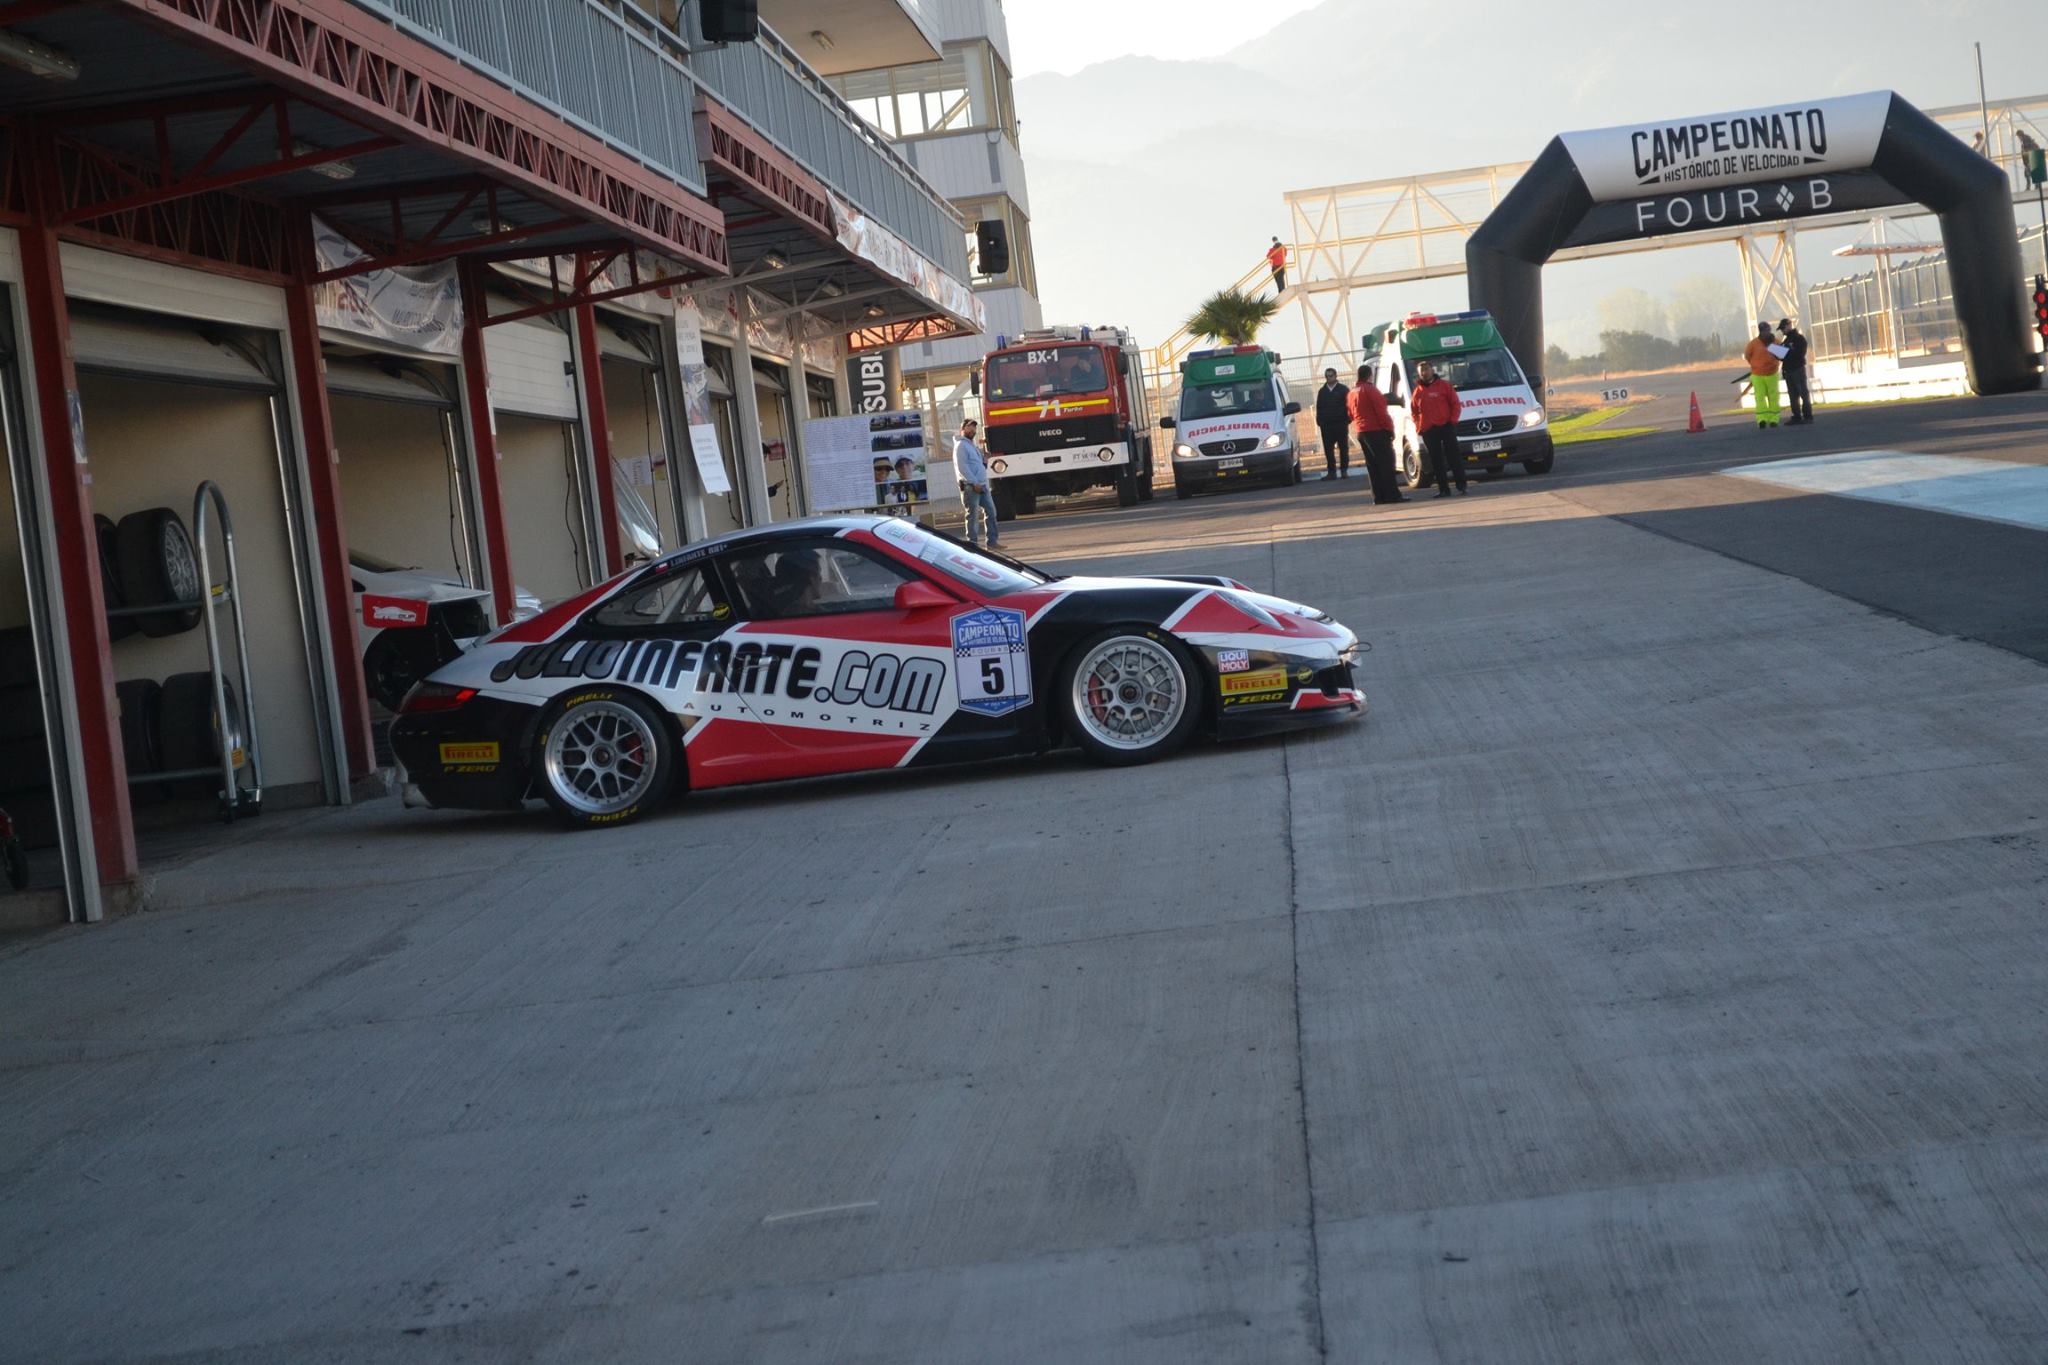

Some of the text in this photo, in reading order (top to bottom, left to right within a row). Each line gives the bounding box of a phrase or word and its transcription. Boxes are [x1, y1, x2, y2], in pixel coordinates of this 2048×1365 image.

[1631, 108, 1828, 179] CAMPEONATO
[1664, 154, 1800, 183] HISTÓRICO DE VELOCIDAD
[1636, 179, 1833, 232] FOUR B
[1027, 349, 1059, 364] BX-1
[1603, 388, 1628, 401] 150
[1036, 399, 1061, 418] 71
[1039, 429, 1062, 437] IVECO
[958, 622, 1020, 643] CAMPEONATO
[1220, 650, 1247, 661] LIQUI
[1221, 660, 1248, 671] MOLY
[980, 657, 1005, 695] 5
[1226, 673, 1281, 690] PIRELLI
[1239, 692, 1284, 704] ZERO
[684, 702, 931, 731] AUTOMOTRIZ
[444, 746, 493, 759] PIRELLI
[457, 765, 496, 773] ZERO
